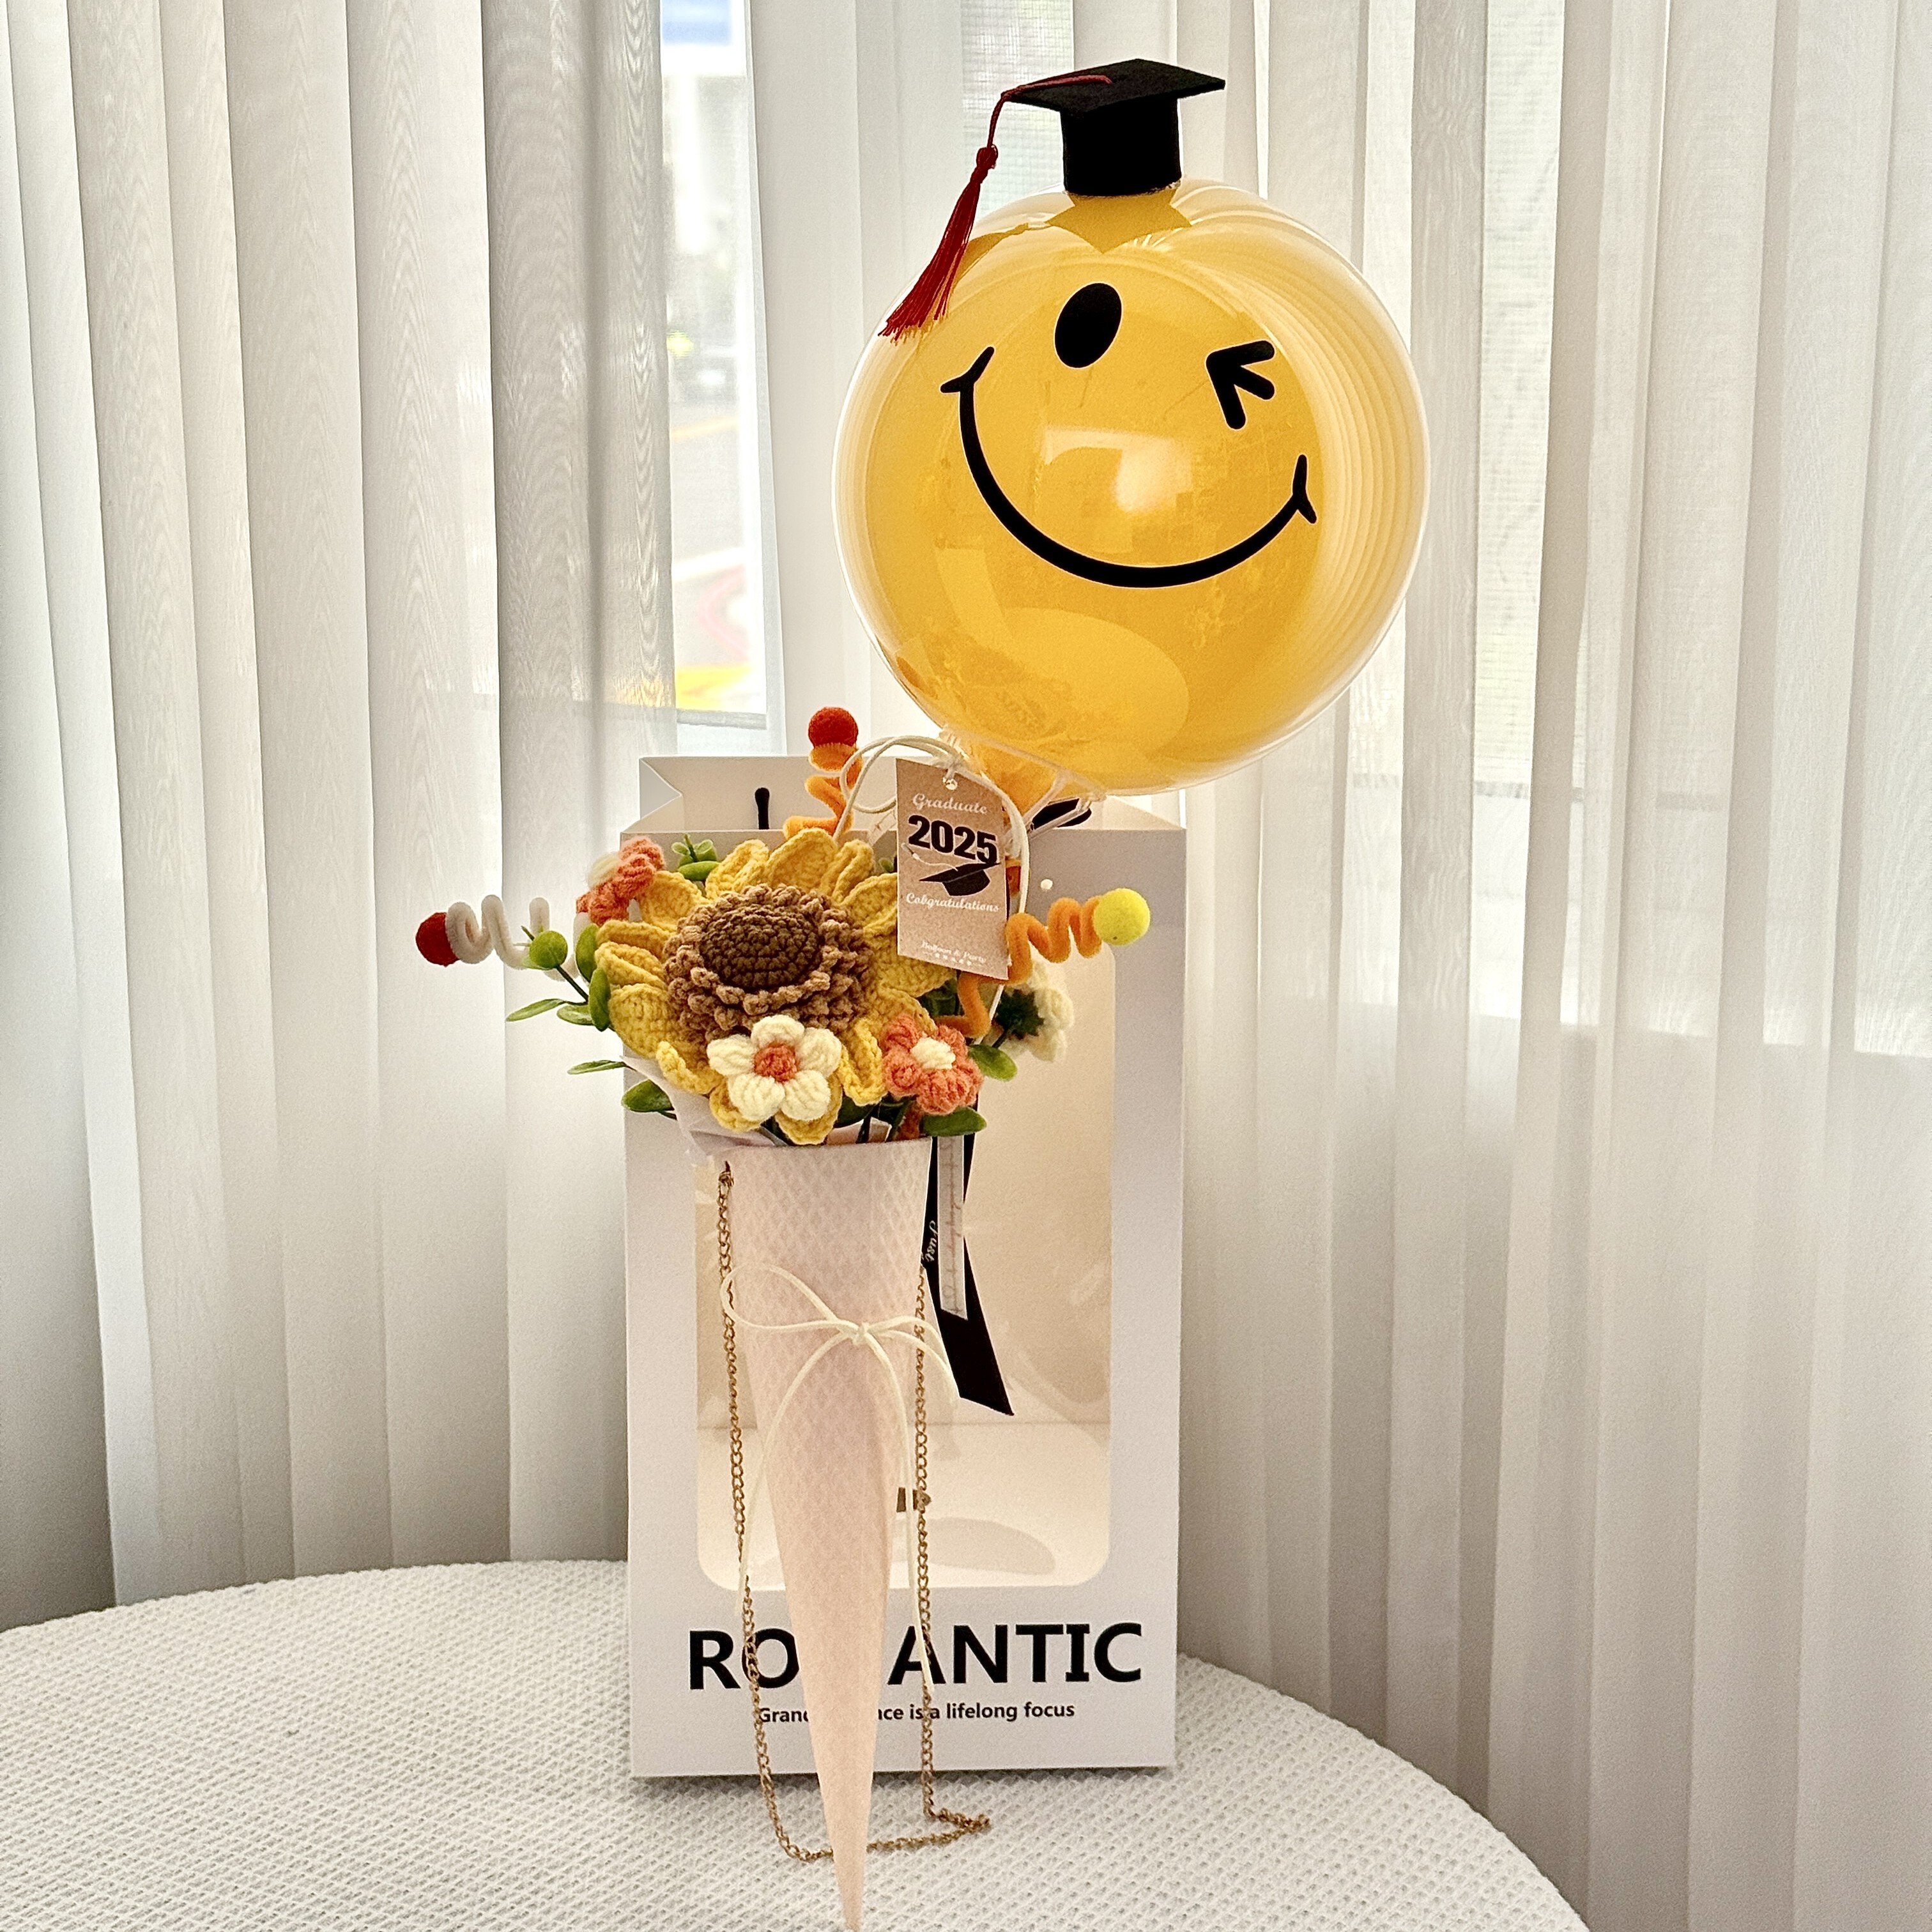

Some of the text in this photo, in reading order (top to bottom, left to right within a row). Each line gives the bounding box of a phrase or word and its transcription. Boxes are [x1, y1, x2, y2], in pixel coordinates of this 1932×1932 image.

[912, 793, 987, 814] Graduate
[907, 814, 998, 863] 2025
[689, 1622, 1142, 1690] ROANTIC
[910, 1703, 923, 1719] is
[930, 1707, 940, 1719] a
[946, 1702, 1017, 1722] lifelong
[1024, 1701, 1075, 1717] focus
